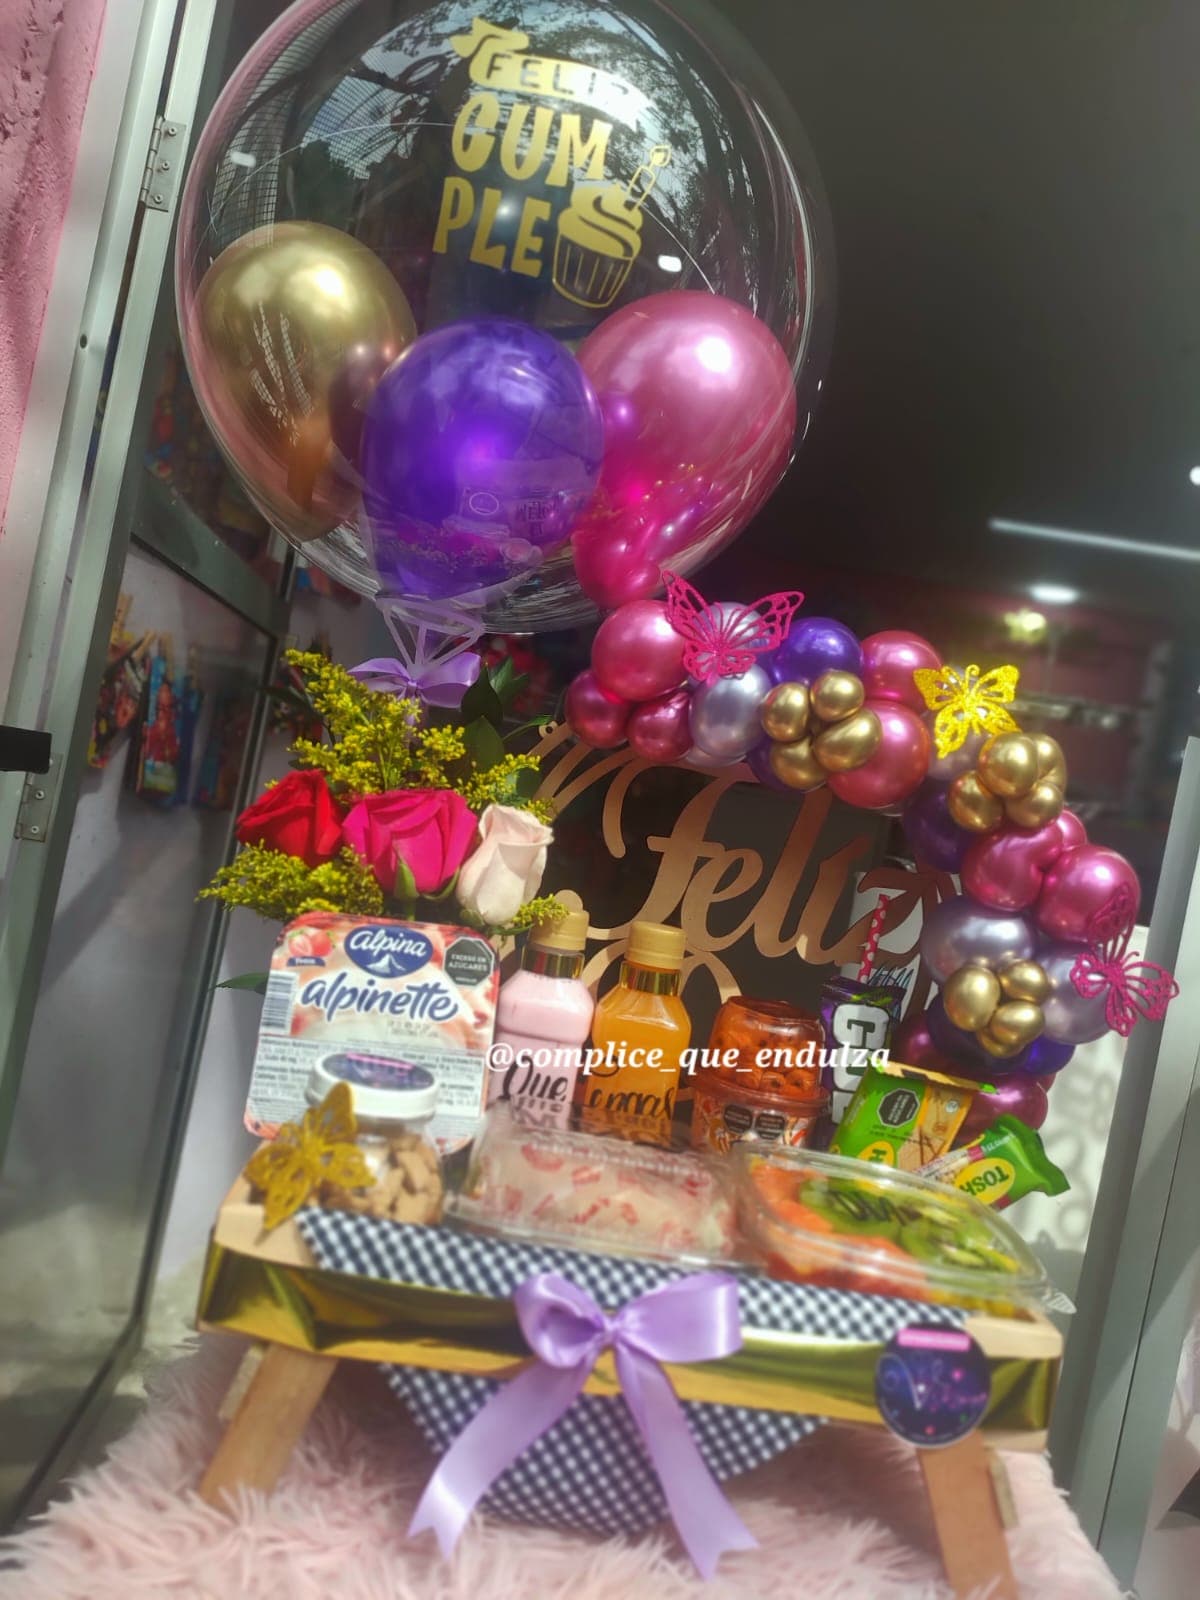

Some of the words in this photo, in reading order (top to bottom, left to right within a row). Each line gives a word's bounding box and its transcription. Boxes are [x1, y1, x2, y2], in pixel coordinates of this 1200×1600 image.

[452, 92, 613, 187] CUM
[432, 176, 551, 278] PLE
[349, 928, 427, 958] alpina
[301, 972, 459, 1022] alpinette
